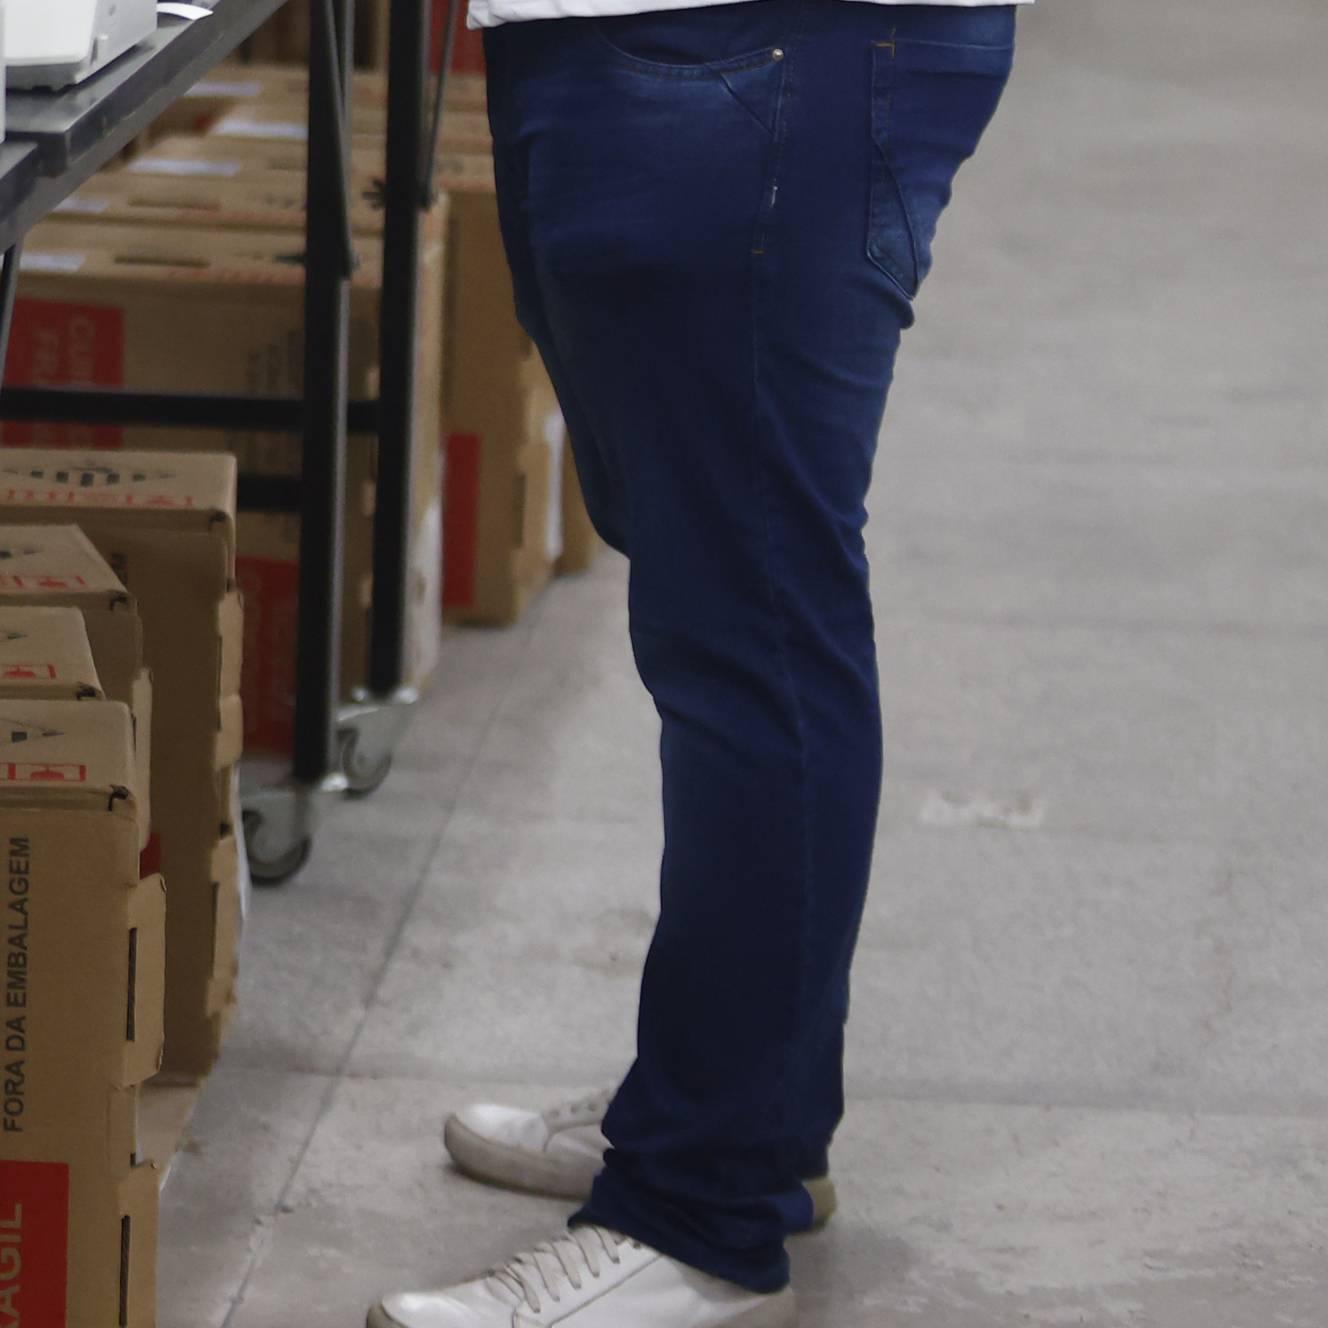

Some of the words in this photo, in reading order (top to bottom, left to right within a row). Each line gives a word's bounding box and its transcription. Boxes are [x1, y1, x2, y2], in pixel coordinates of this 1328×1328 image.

[6, 837, 30, 1009] EMBALAGEM
[5, 1016, 26, 1052] DA
[3, 1060, 25, 1133] FORA
